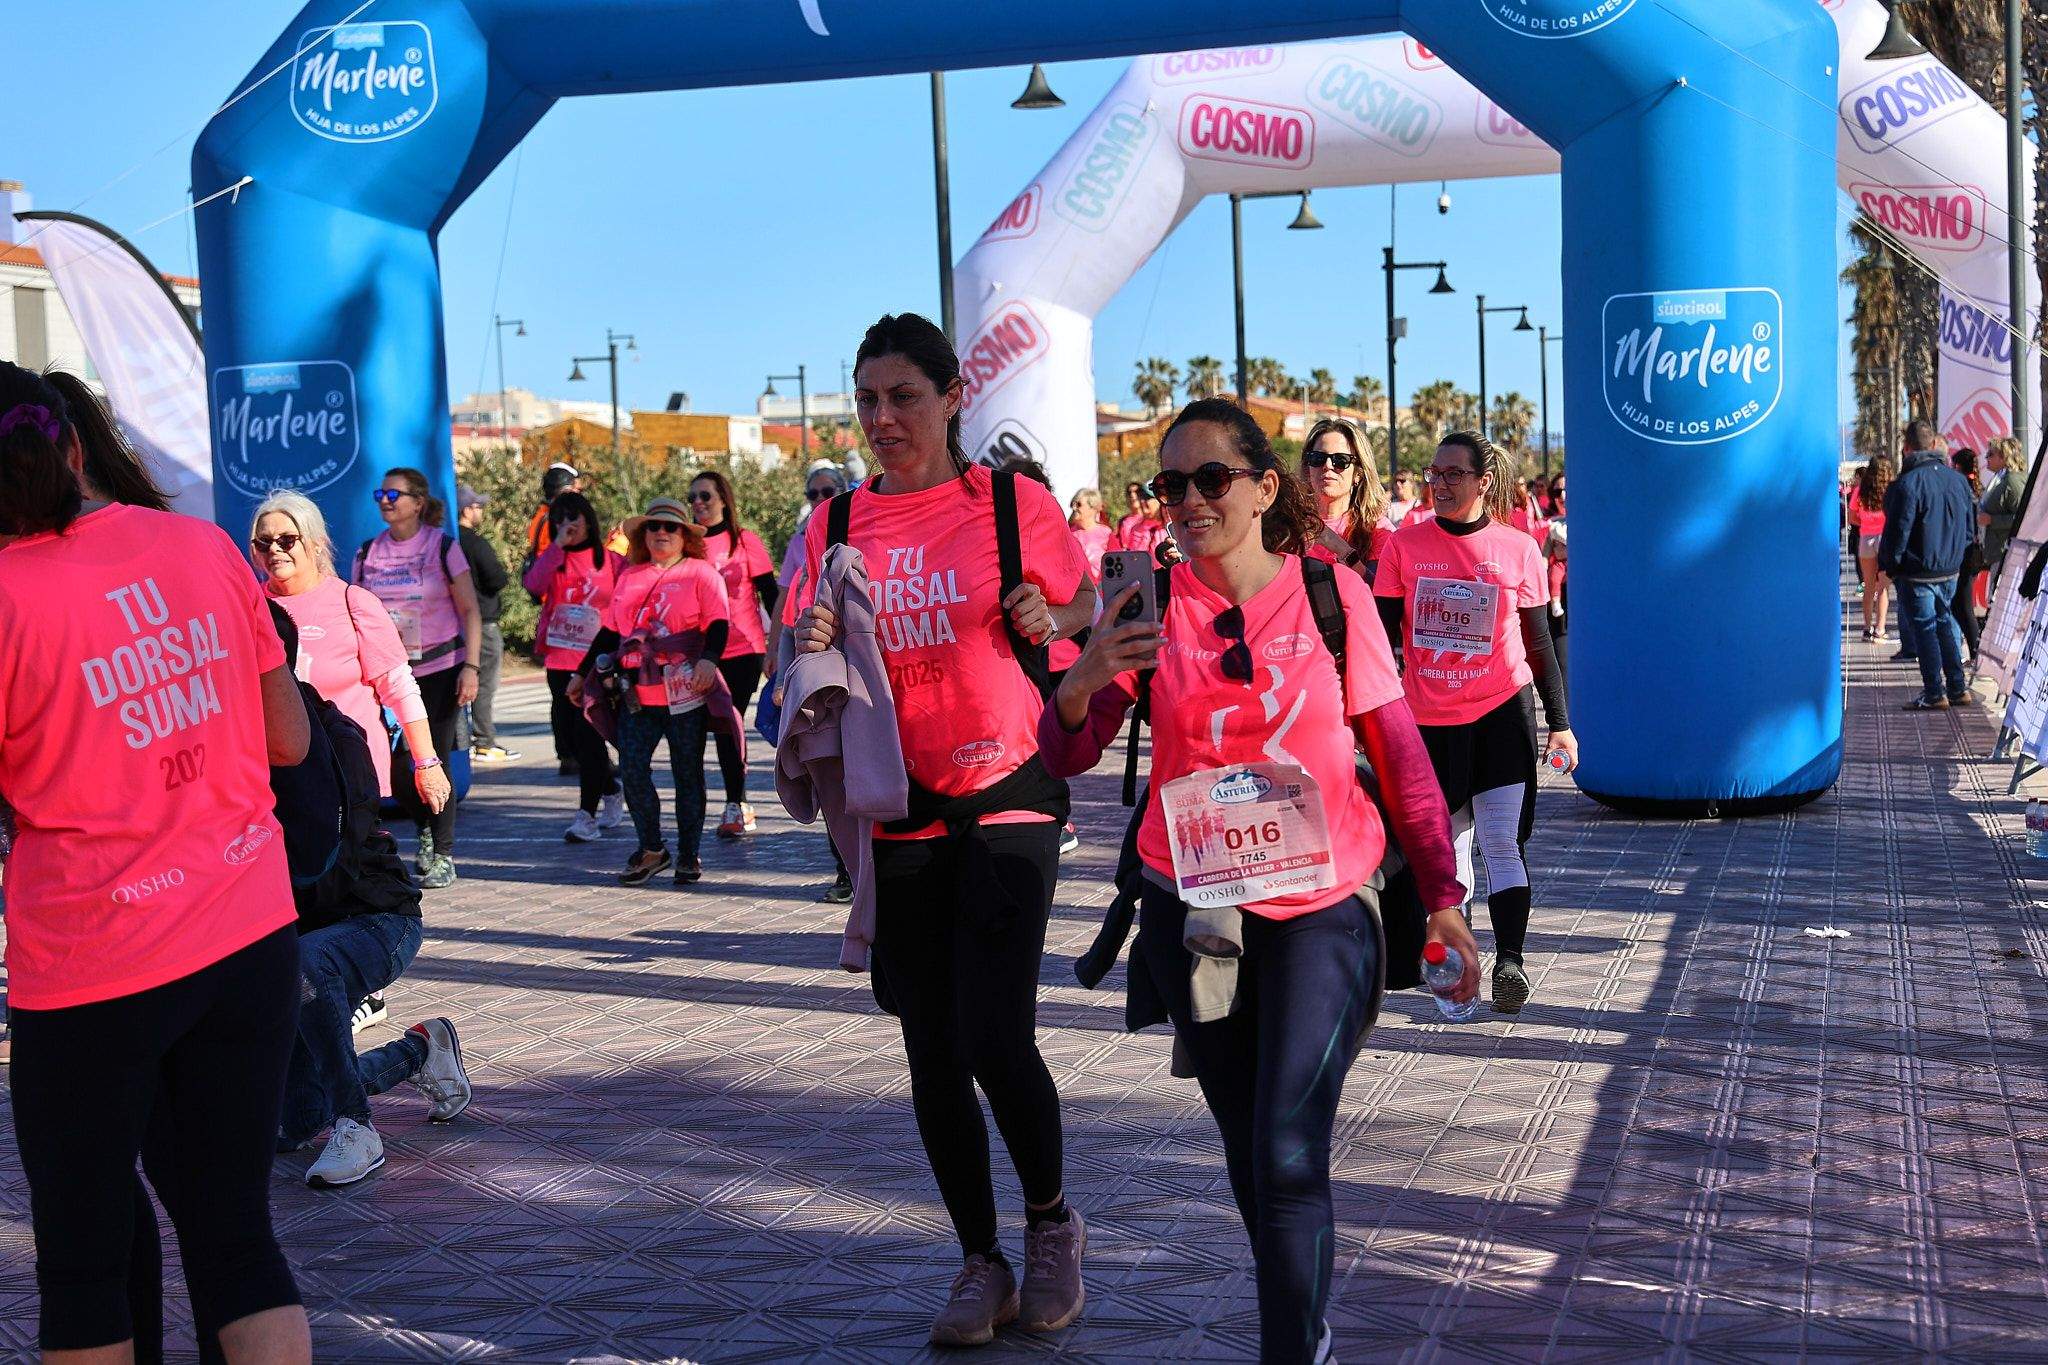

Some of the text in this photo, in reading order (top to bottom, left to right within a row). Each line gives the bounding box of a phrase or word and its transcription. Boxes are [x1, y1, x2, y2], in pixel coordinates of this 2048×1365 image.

[1499, 0, 1621, 30] HIJA DE LOS ALPES
[1163, 48, 1274, 77] COSMO
[300, 49, 426, 111] Marlene
[1319, 63, 1430, 146] COSMO
[1854, 66, 1968, 139] COSMO
[334, 121, 352, 134] DE
[354, 122, 380, 135] LOS
[383, 106, 419, 132] ALPES
[1192, 103, 1303, 161] COSMO
[1065, 113, 1147, 219] COSMO
[1861, 191, 1973, 241] COSMO
[1613, 323, 1772, 404] Marlene
[222, 392, 347, 464] Marlene
[1621, 399, 1760, 435] HIJA DE LOS ALPES
[296, 458, 338, 487] ALPES
[887, 544, 925, 576] TU
[1414, 563, 1449, 571] OYSHO
[105, 577, 170, 635] TU
[868, 569, 968, 616] ORSAL
[878, 609, 957, 653] UMA
[1441, 611, 1471, 625] 016
[80, 612, 230, 709] DORSAL
[889, 659, 945, 689] 2025
[1447, 670, 1457, 680] DE
[1459, 670, 1468, 680] LA
[1447, 680, 1462, 688] 2025
[119, 669, 223, 750] SUMA
[1215, 782, 1269, 800] ASTURIANA
[1224, 821, 1281, 850] 016
[1198, 871, 1230, 884] CARRERA
[1231, 869, 1240, 879] DE
[1241, 867, 1251, 877] LA
[1251, 863, 1275, 873] MUJER
[1280, 857, 1313, 869] VALENCIA
[1239, 851, 1267, 865] 7745
[111, 868, 185, 904] OYSHO
[1198, 873, 1318, 901] OYSHO Santander
